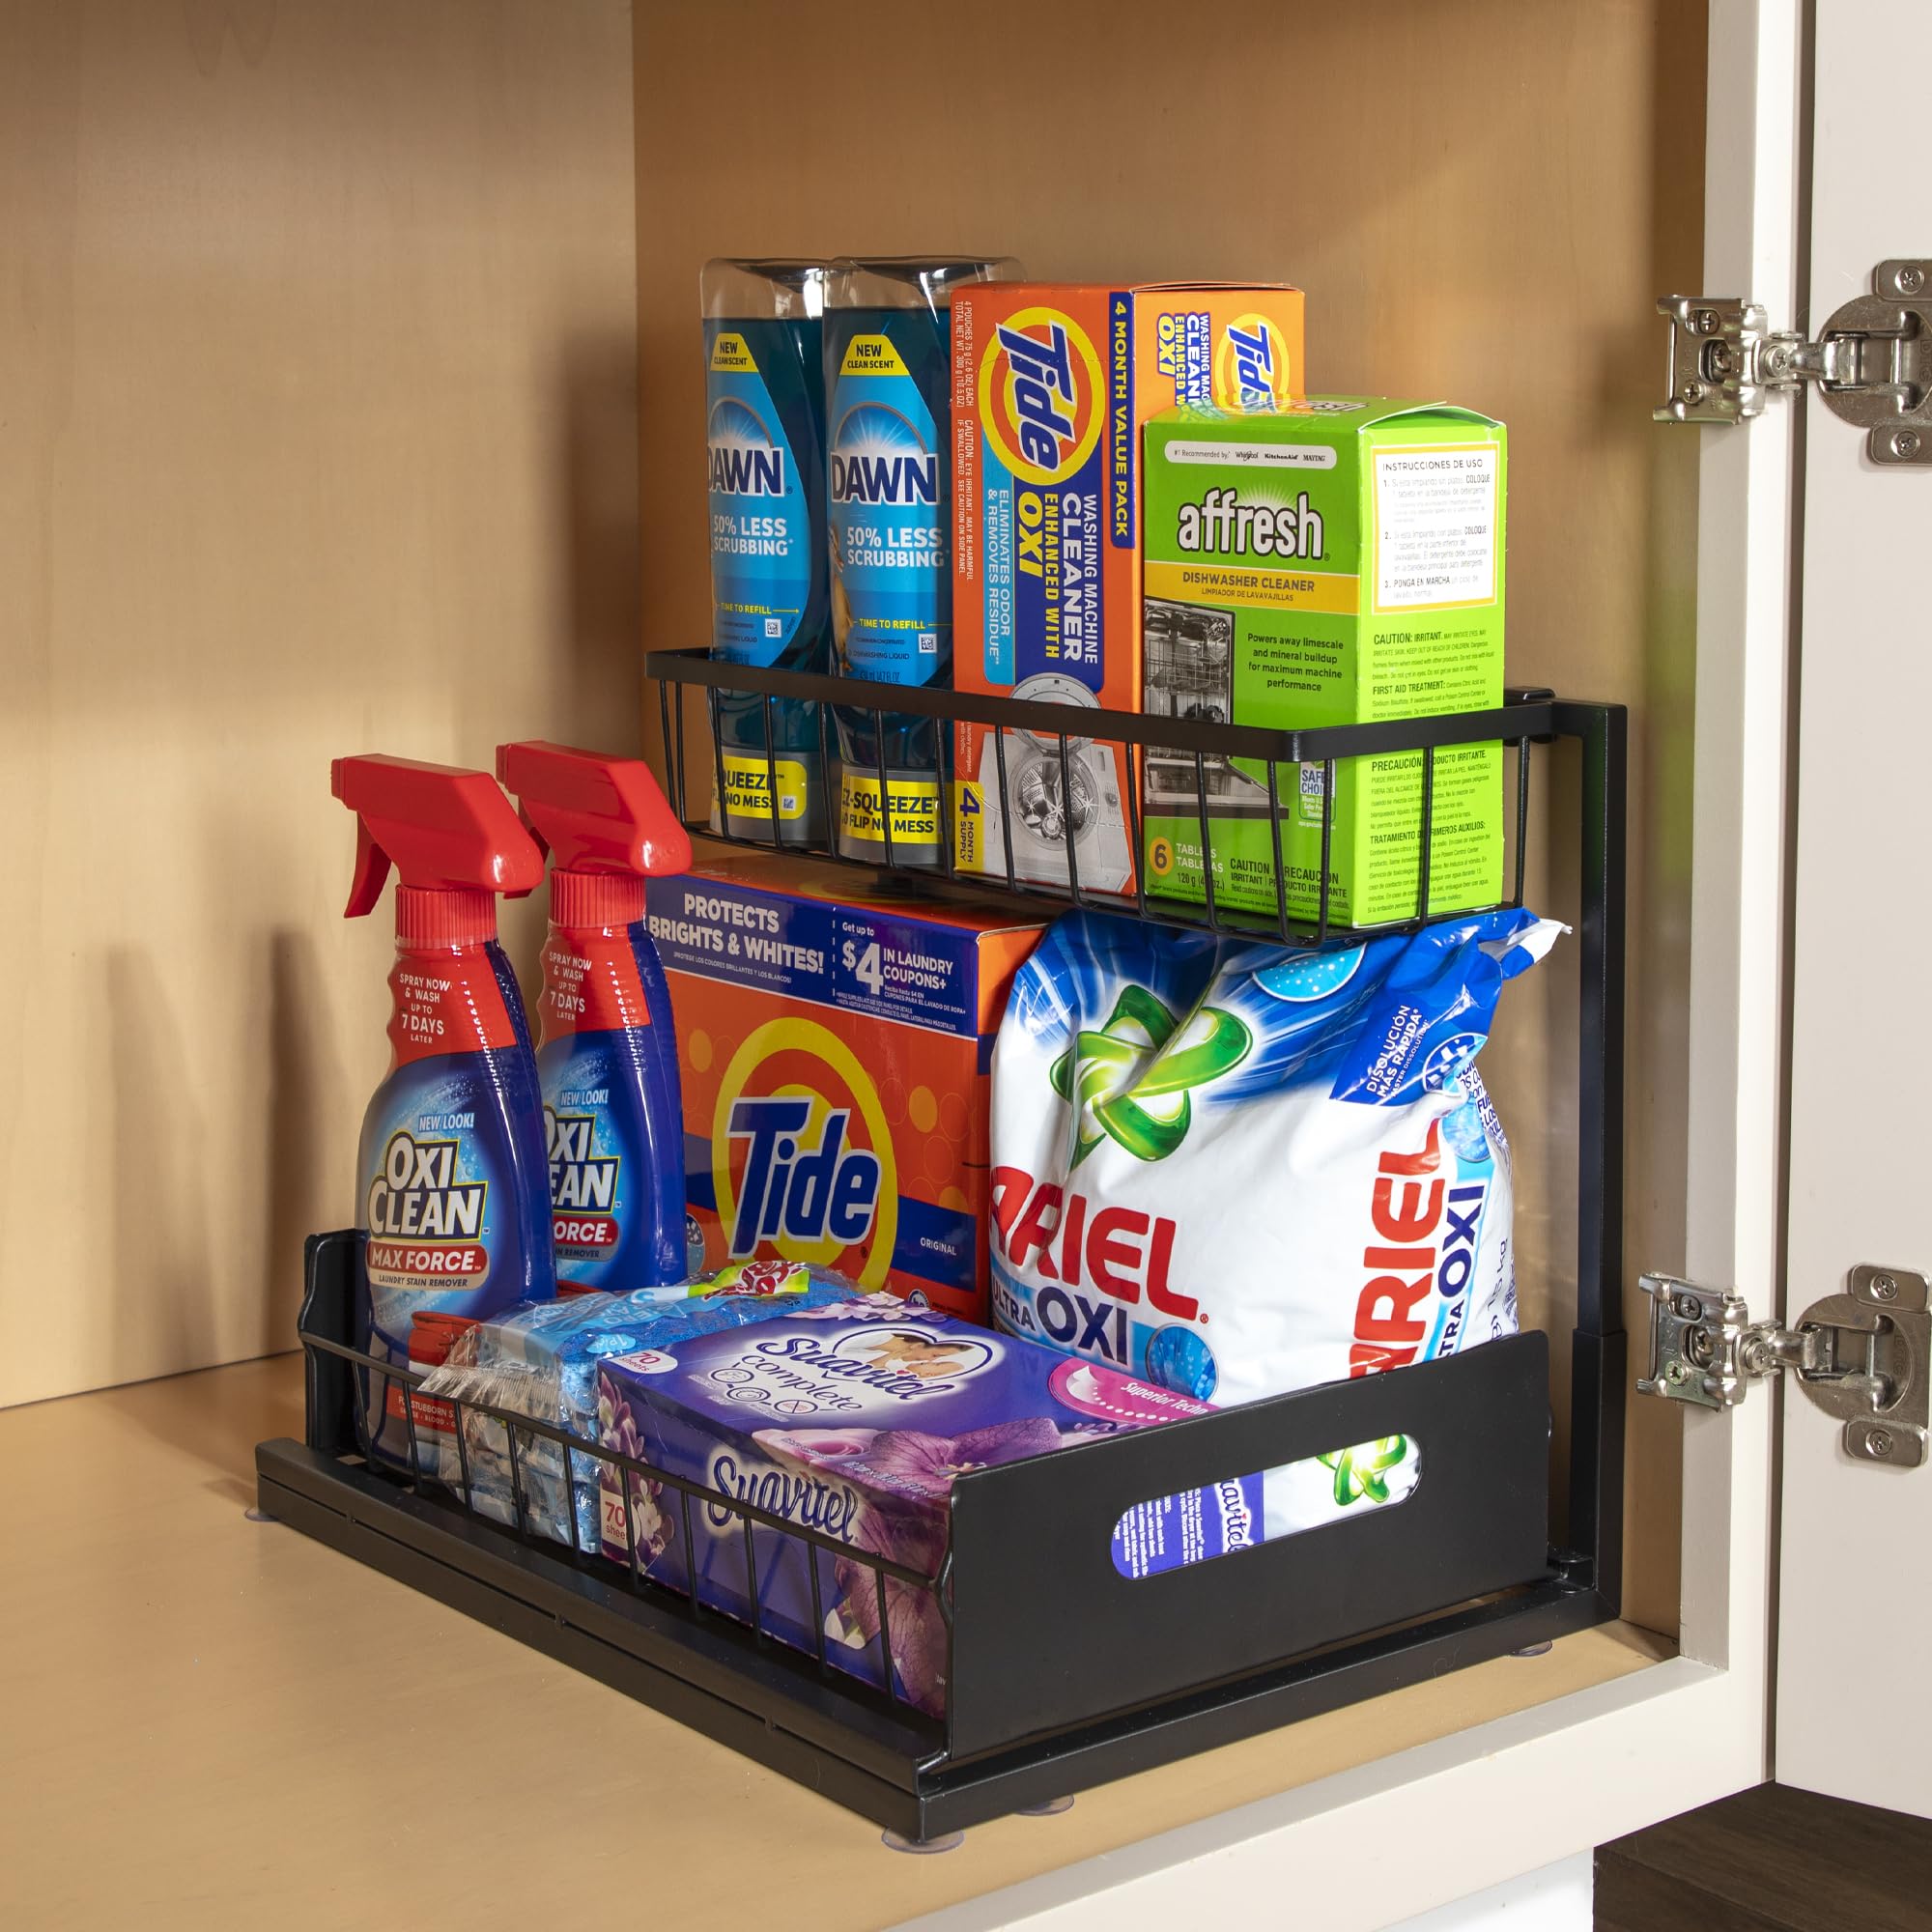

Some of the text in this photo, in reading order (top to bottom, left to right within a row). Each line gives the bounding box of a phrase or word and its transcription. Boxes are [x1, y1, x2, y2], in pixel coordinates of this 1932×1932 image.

[720, 342, 738, 355] NEW
[856, 344, 882, 357] NEW
[1158, 315, 1175, 375] OXI
[1175, 316, 1186, 390] ENHANCED
[1200, 315, 1209, 373] WASHING
[728, 357, 748, 366] SCENT
[847, 360, 895, 369] CLEAN SCENT
[996, 320, 1076, 471] Tide
[1115, 301, 1128, 537] 4 MONTH VALUE PACK
[965, 419, 974, 460] CAUTION:
[1182, 449, 1218, 458] Recommended
[1236, 452, 1258, 462] Whirlpool
[1383, 459, 1483, 471] INSTRUCCIONES DE USO
[831, 456, 936, 502] DAWN
[1466, 474, 1490, 483] COLOQUE
[714, 517, 787, 537] 50% LESS
[1178, 487, 1323, 560] affresh
[1464, 526, 1486, 535] COLOQUE
[847, 526, 942, 548] 50% LESS
[987, 489, 999, 583] & REMOVES
[1018, 491, 1043, 578] OXI
[714, 538, 788, 556] SCRUBBING
[847, 549, 945, 568] SCRUBBING
[999, 489, 1010, 636] ELIMINATES ODOR
[1045, 493, 1059, 658] ENHANCED WITH
[1063, 493, 1082, 661] CLEANER
[1084, 495, 1097, 665] WASHING MACHINE
[1182, 572, 1315, 591] DISHWASHER CLEANER
[1394, 578, 1415, 587] PONGA
[1426, 576, 1451, 585] MARCHA
[1202, 588, 1235, 597] LIMPIADOR
[1246, 591, 1294, 601] LAVAVAJILLAS
[745, 605, 772, 614] REFILL
[859, 618, 925, 630] TIME TO REFILL
[1248, 634, 1344, 650] Powers away limescale
[1374, 632, 1443, 645] CAUTION: IRRITANT.
[1253, 649, 1338, 665] and mineral buildup
[1248, 662, 1343, 679] for maximum machine
[1267, 680, 1321, 692] performance
[1373, 686, 1393, 696] FIRST
[1395, 684, 1406, 694] AID
[1408, 680, 1446, 692] TREATMENT:
[960, 788, 980, 817] 4
[850, 814, 934, 833] FLIP MESS
[1370, 821, 1486, 844] TRATAMIENTO AUXILIOS:
[1155, 844, 1167, 869] 6
[1177, 843, 1216, 859] TABLES
[1177, 857, 1223, 873] TABLEAS
[1231, 858, 1269, 875] CAUTION
[1178, 873, 1189, 885] 120
[1231, 873, 1262, 885] IRRITANT
[684, 893, 780, 933] PROTECTS
[842, 922, 875, 937] Get up to
[649, 916, 824, 974] BRIGHTS & WHITES!
[549, 952, 591, 970] SPRAY NOW
[705, 958, 753, 975] COLORES BRILLANTES
[842, 940, 883, 995] $4
[883, 949, 953, 976] IN LAUNDRY
[400, 974, 450, 991] SPRAY NOW
[562, 968, 583, 981] WASH
[415, 989, 440, 1003] WASH
[558, 981, 576, 992] UP TO
[412, 1003, 433, 1014] UP TO
[551, 991, 585, 1012] 7 DAYS
[924, 999, 943, 1010] LAVADO
[402, 1014, 444, 1036] 7 DAYS
[556, 1011, 576, 1020] LATER
[411, 1035, 433, 1043] LATER
[1366, 1006, 1411, 1093] DISOLUCIÓN
[1376, 1067, 1398, 1097] MÁS
[561, 1090, 609, 1106] NEW LOOK!
[419, 1113, 474, 1131] NEW LOOK!
[386, 1136, 453, 1190] OXI
[549, 1163, 614, 1208] EAN
[726, 1096, 881, 1260] Tide
[369, 1179, 481, 1235] CLEAN
[554, 1221, 608, 1242] ORCE
[920, 1236, 956, 1256] ORIGINAL
[990, 1166, 1199, 1321] ARIEL
[1438, 1186, 1485, 1298] OXI
[371, 1246, 475, 1271] MAX FORCE
[564, 1248, 599, 1258] REMOVER
[379, 1274, 468, 1287] LAUNDRY STAIN REMOVER
[992, 1276, 1128, 1366] ULTRA OXI
[631, 1352, 661, 1366] 70
[755, 1338, 954, 1401] Suavitel
[742, 1354, 862, 1410] complete
[1121, 1382, 1208, 1416] Superior Techn
[412, 1401, 446, 1417] STUBBORN
[708, 1455, 859, 1544] Suavitel
[605, 1501, 626, 1528] 70
[606, 1525, 626, 1540] shee
